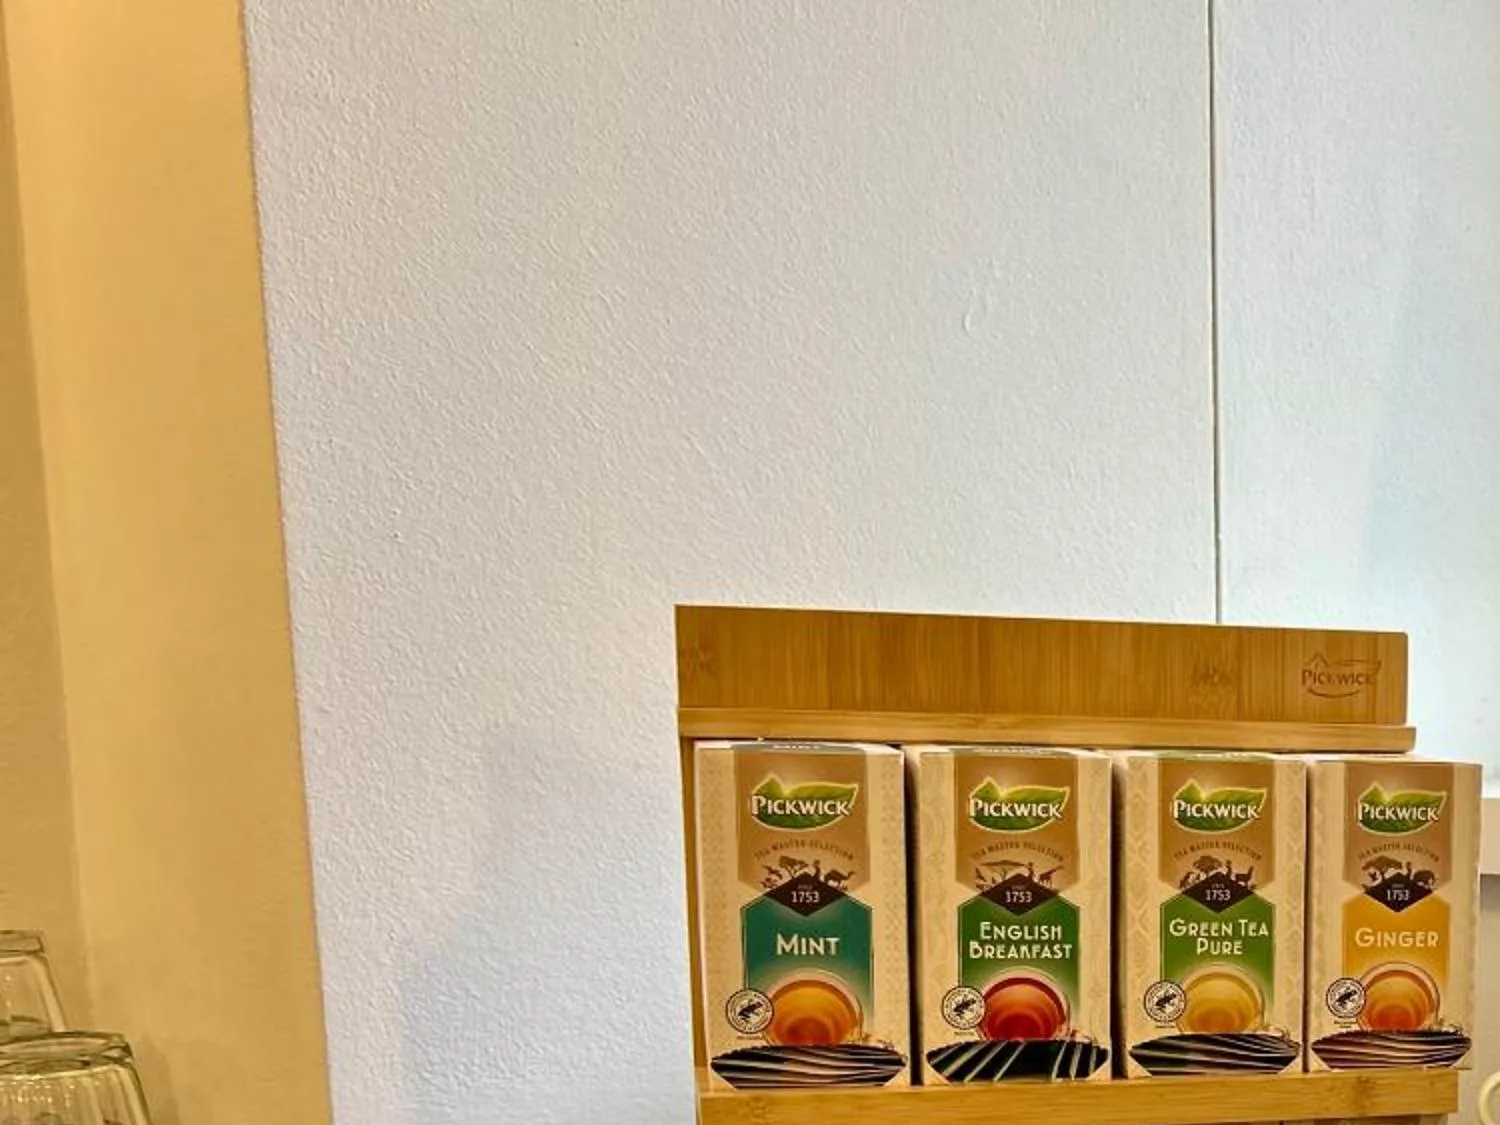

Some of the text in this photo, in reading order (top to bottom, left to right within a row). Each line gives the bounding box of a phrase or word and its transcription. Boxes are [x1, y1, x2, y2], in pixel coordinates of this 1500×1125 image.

[751, 794, 851, 816] PICKWICK
[968, 797, 1063, 819] PICKWICK
[1172, 799, 1261, 820] PICKWICK
[1357, 802, 1440, 822] PICKWICK
[791, 891, 820, 904] 1753
[1005, 891, 1033, 903] 1753
[1205, 889, 1231, 901] 1753
[979, 921, 1063, 942] ENGLISH
[1169, 918, 1270, 938] GREEN TEA
[1354, 927, 1440, 949] GINGER
[775, 932, 840, 957] MINT
[968, 942, 1073, 961] BREAKFAST
[1196, 937, 1243, 956] PURE
